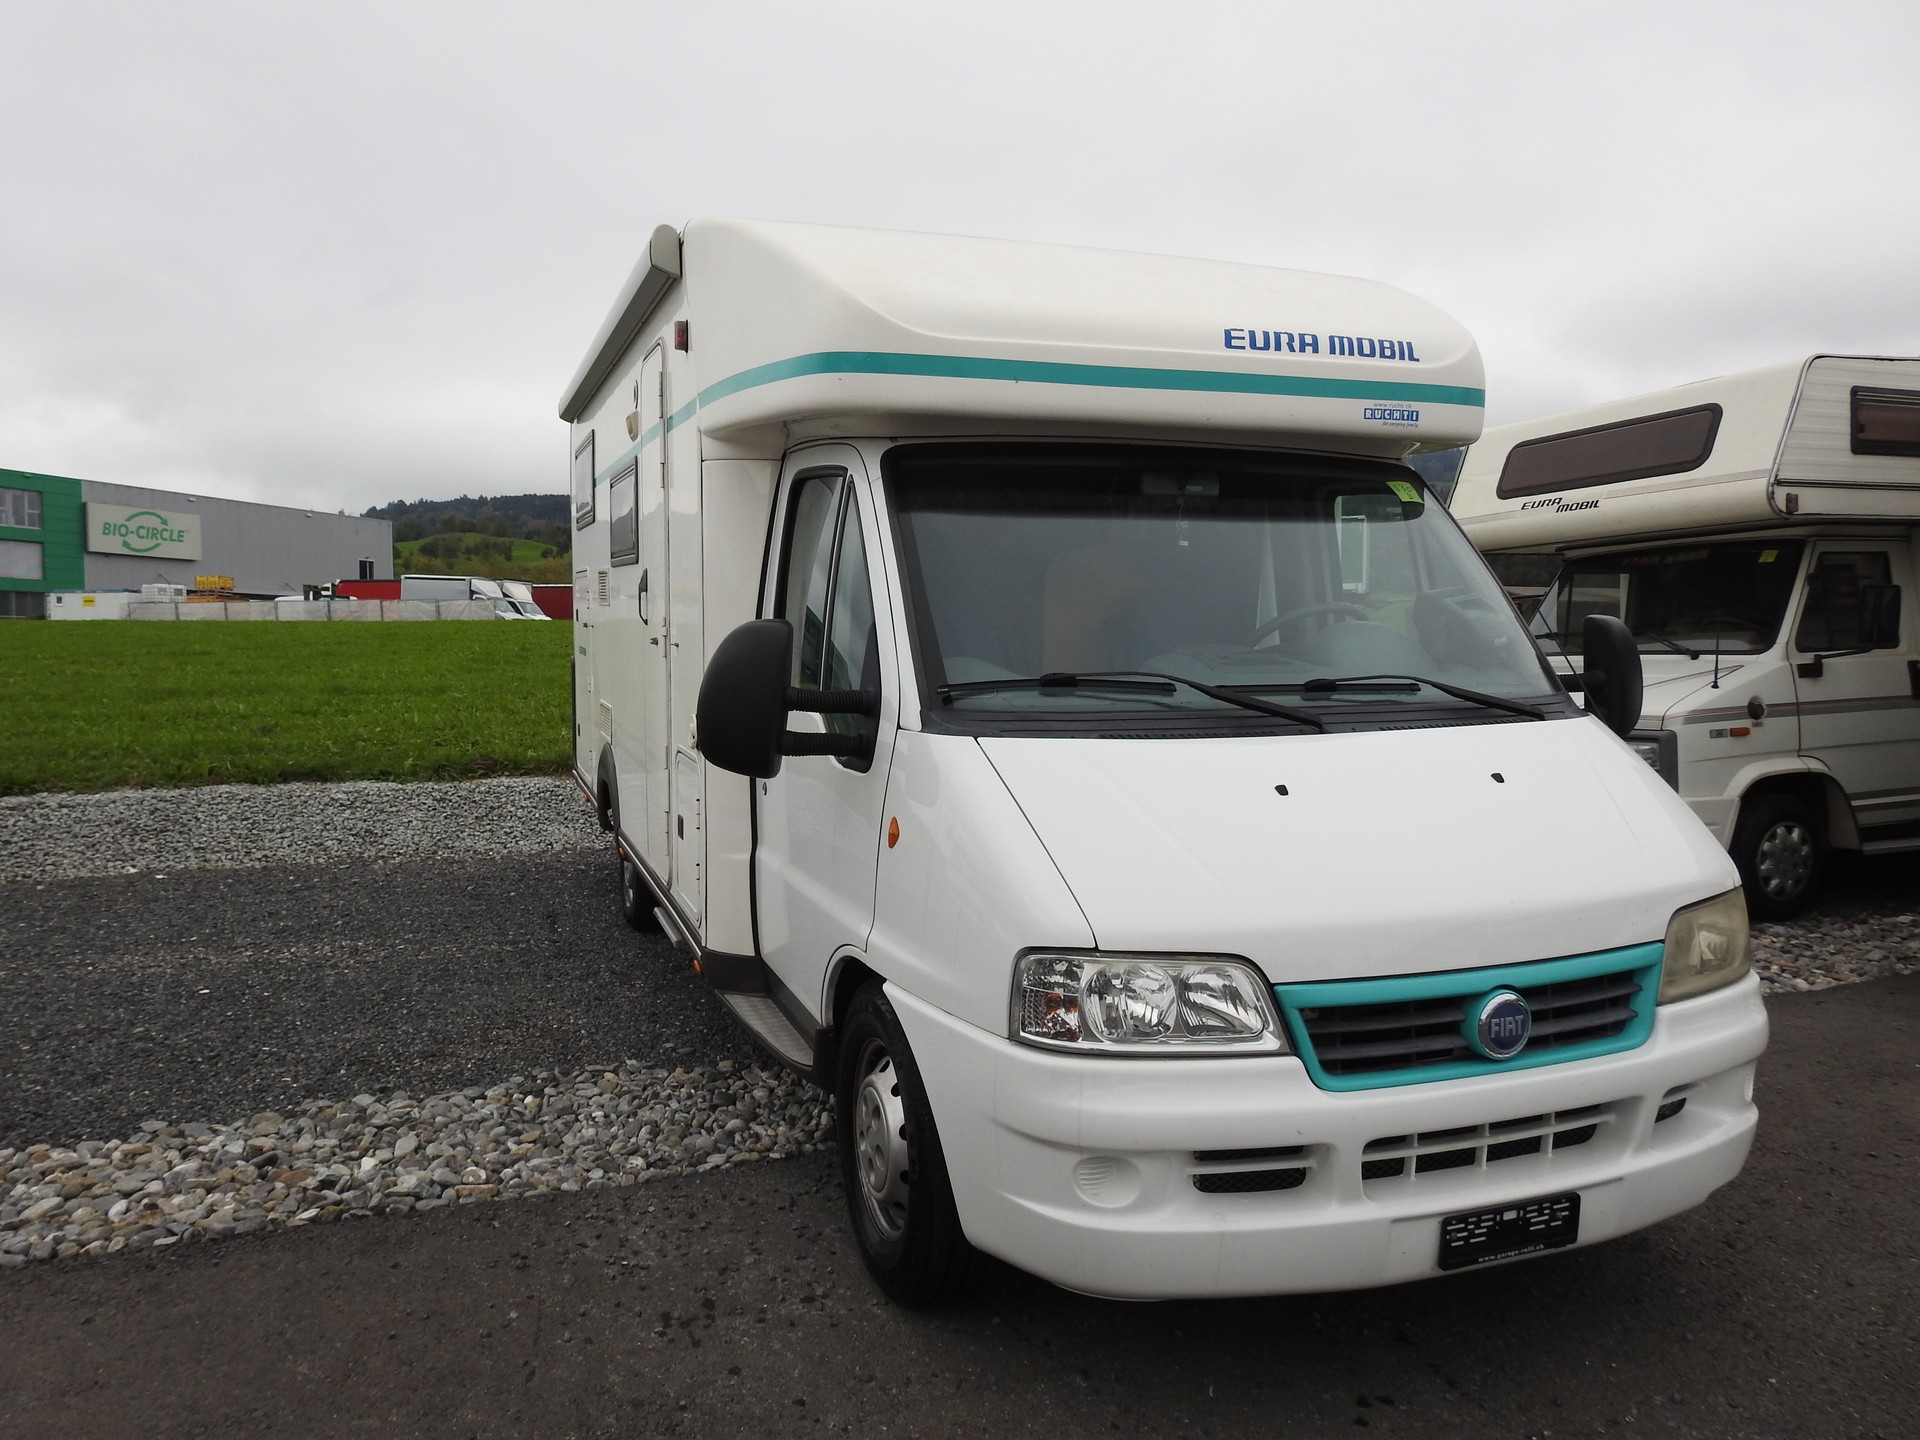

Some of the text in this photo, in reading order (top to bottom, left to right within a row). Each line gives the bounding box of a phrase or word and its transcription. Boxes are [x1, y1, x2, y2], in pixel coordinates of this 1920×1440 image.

[1224, 328, 1420, 362] EURA MOBIL
[1364, 408, 1419, 422] RUCHTI
[1521, 497, 1600, 514] EURA MOBIL
[102, 521, 185, 543] BIO-CIRCLE
[1490, 1014, 1524, 1039] FIAT
